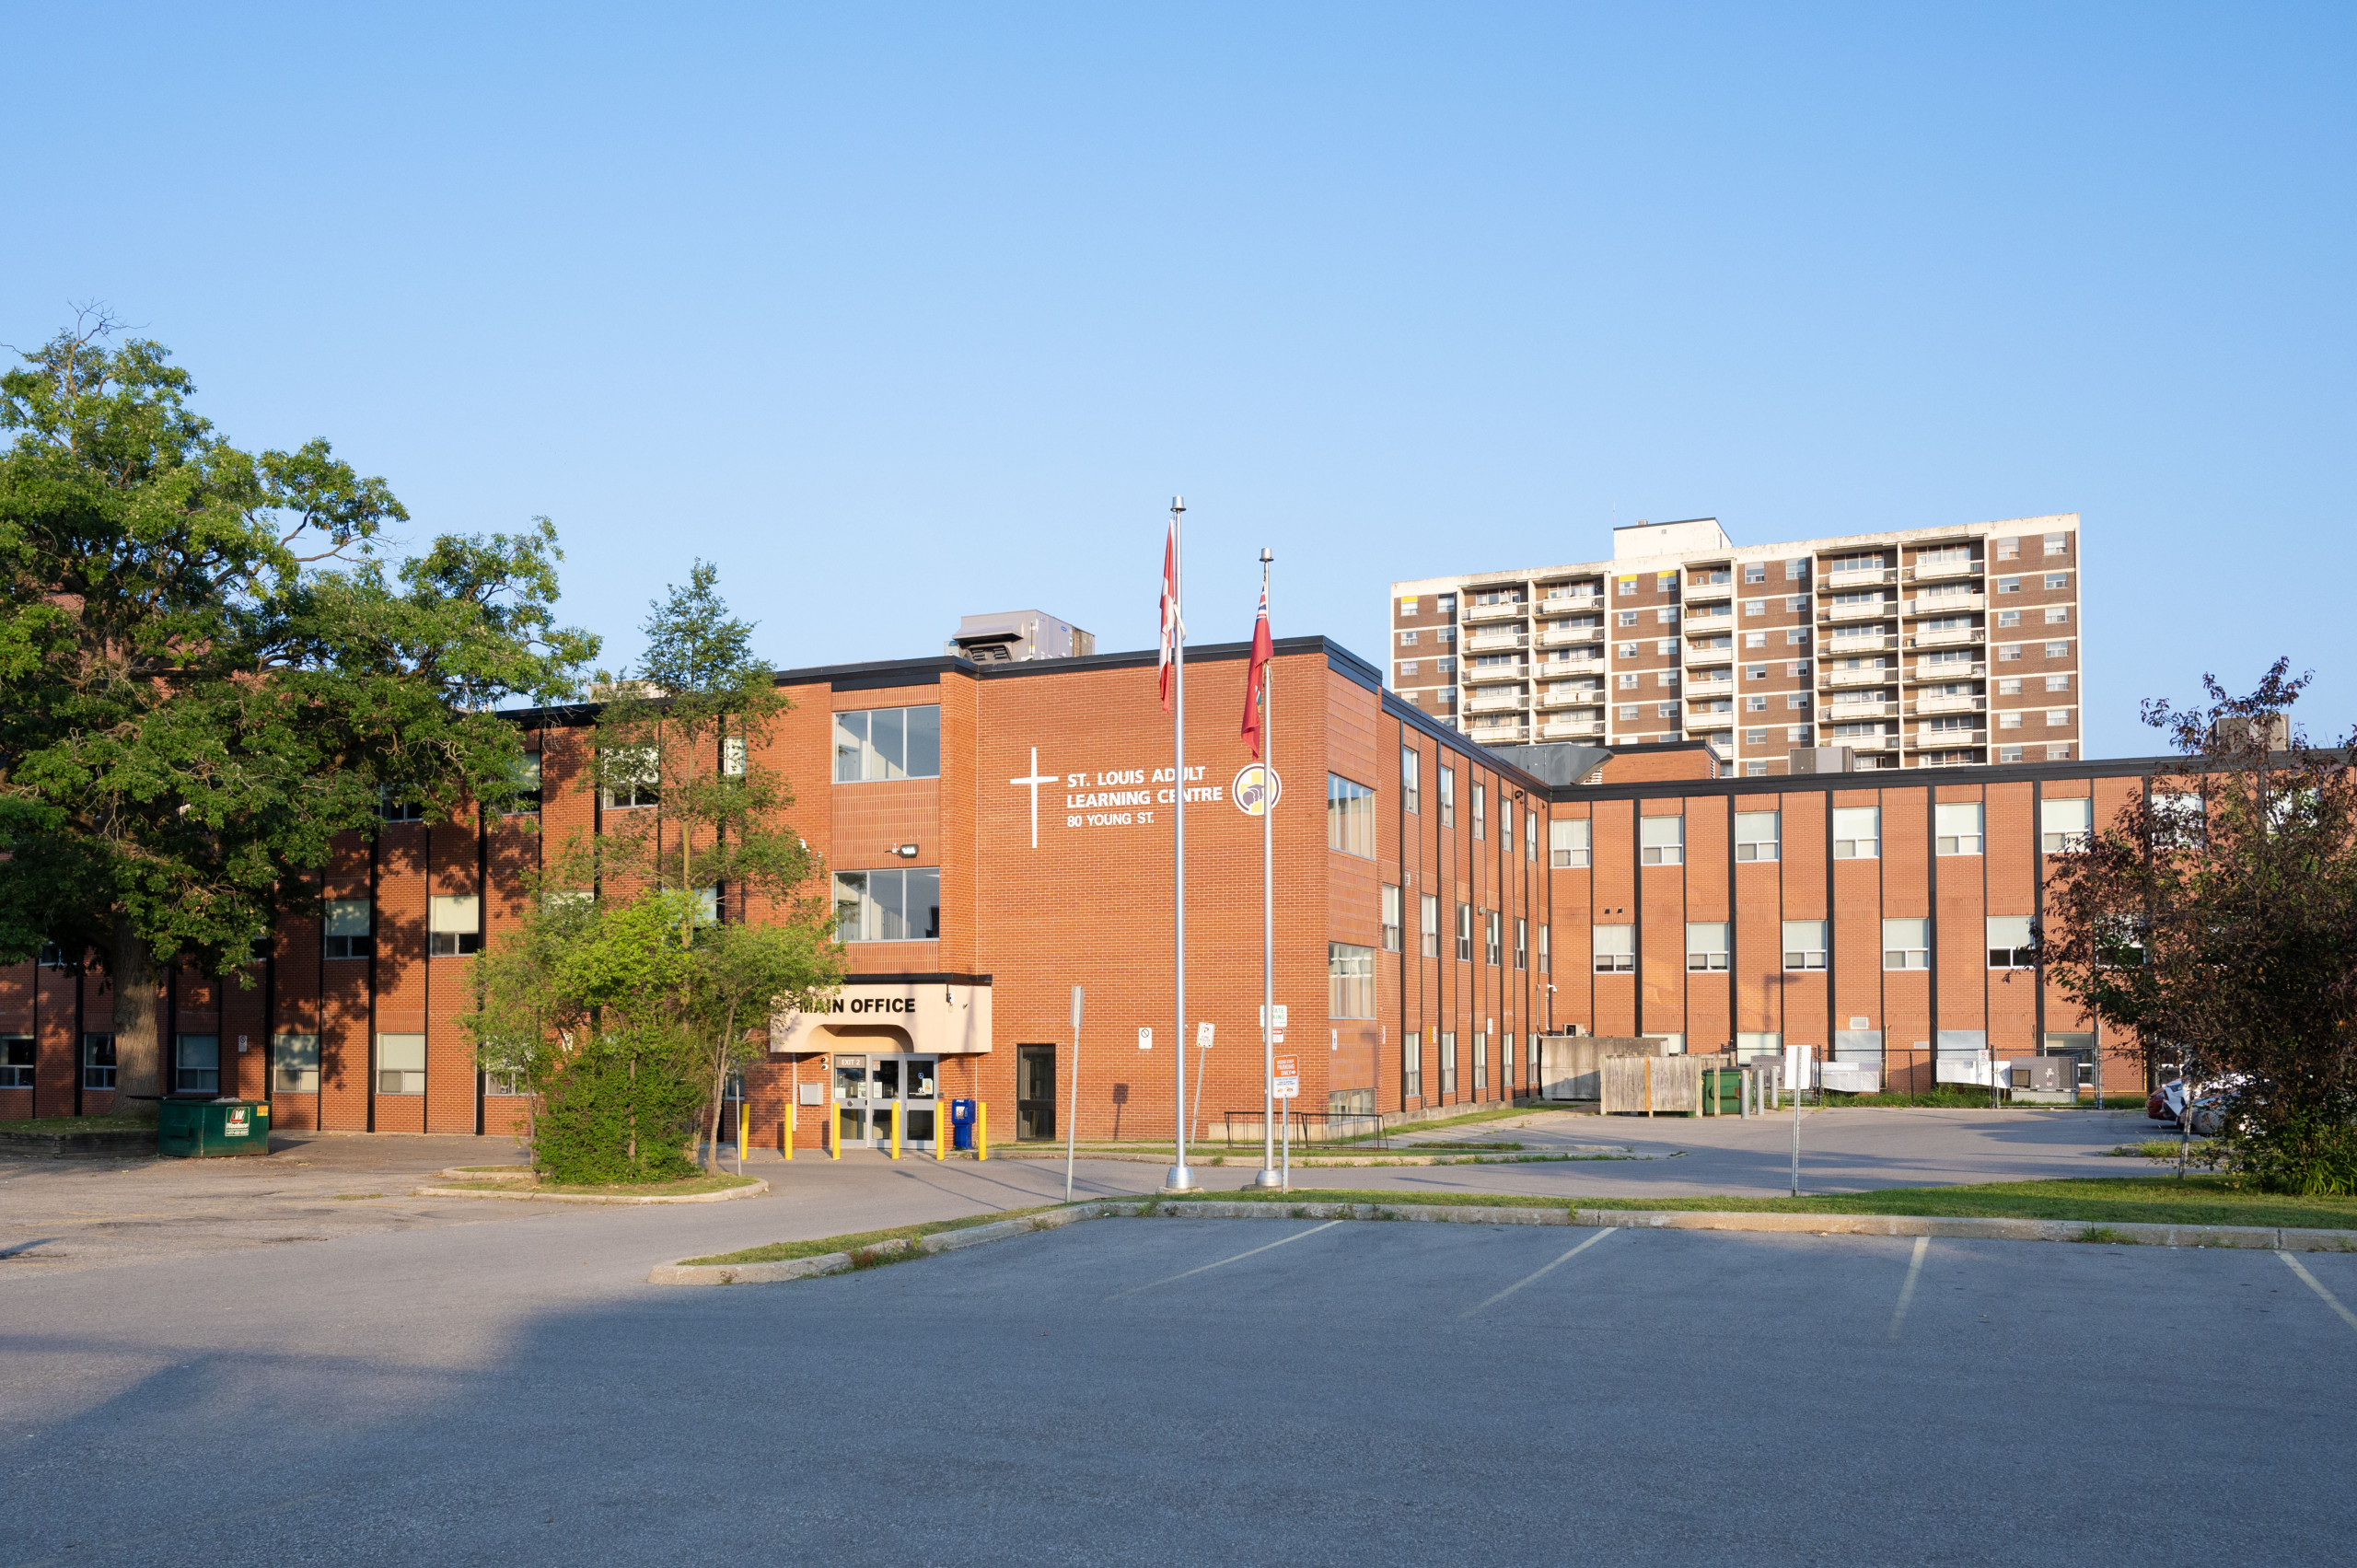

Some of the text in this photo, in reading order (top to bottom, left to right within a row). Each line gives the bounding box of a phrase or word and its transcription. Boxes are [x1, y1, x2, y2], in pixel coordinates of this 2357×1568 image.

[1067, 773, 1090, 787] ST.
[1097, 770, 1144, 785] LOUIS
[1067, 786, 1223, 808] LEARNING CENTRE
[1067, 811, 1155, 828] 80 YOUNG ST.
[851, 998, 915, 1013] OFFICE
